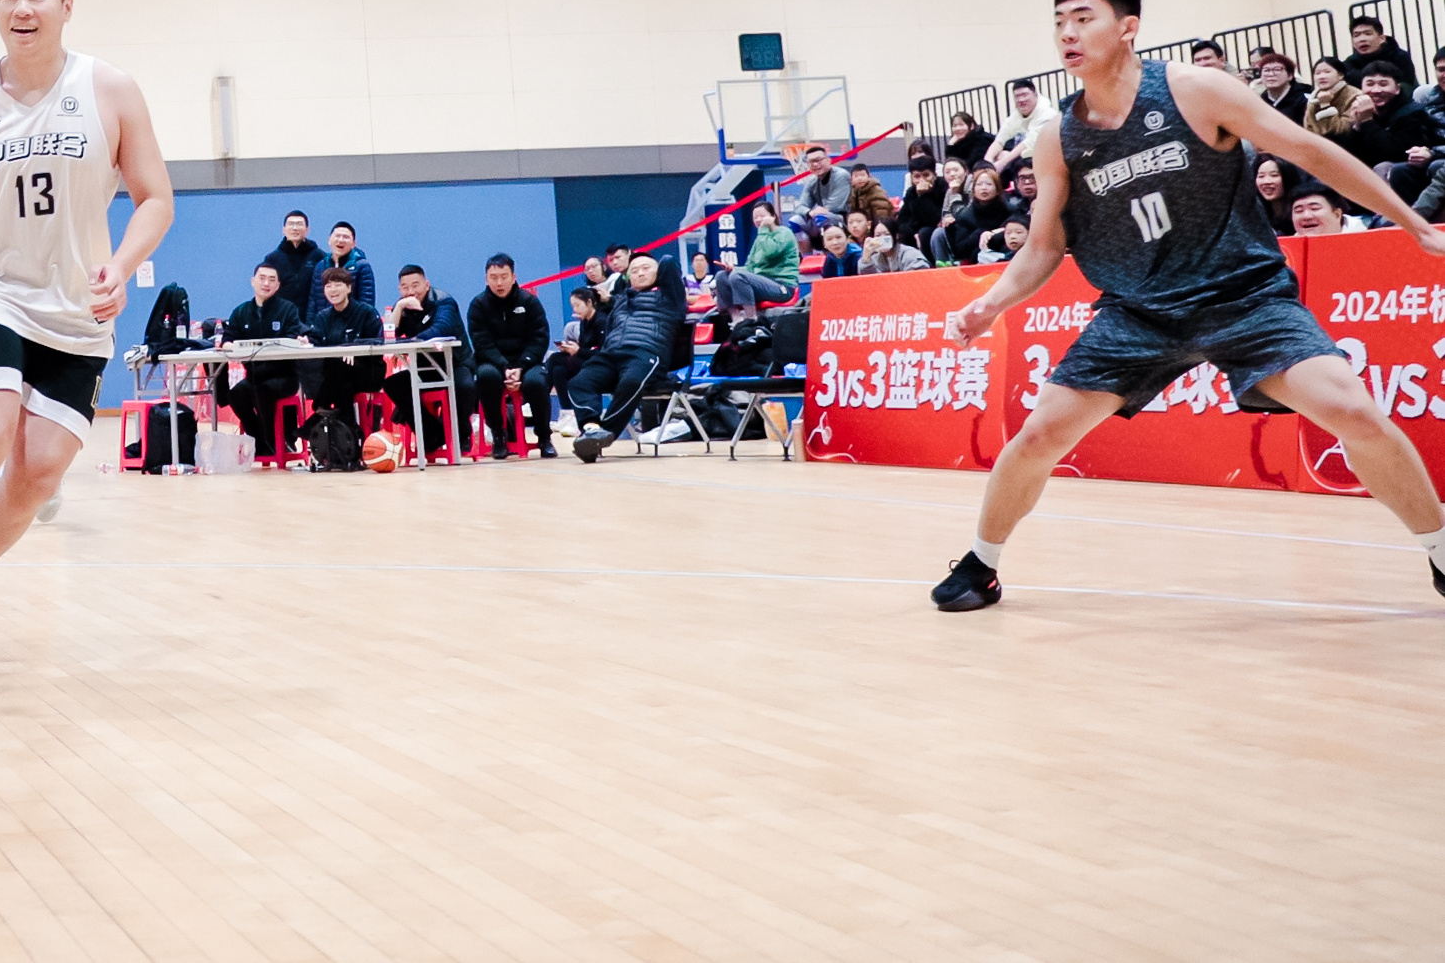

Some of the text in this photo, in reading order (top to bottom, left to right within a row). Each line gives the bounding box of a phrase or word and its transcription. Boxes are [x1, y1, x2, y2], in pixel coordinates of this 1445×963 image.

[1084, 140, 1189, 196] 中国联合
[15, 172, 55, 218] 13
[1130, 191, 1172, 243] 10
[1023, 301, 1099, 333] 2024年
[815, 346, 991, 412] 3vs3篮球赛
